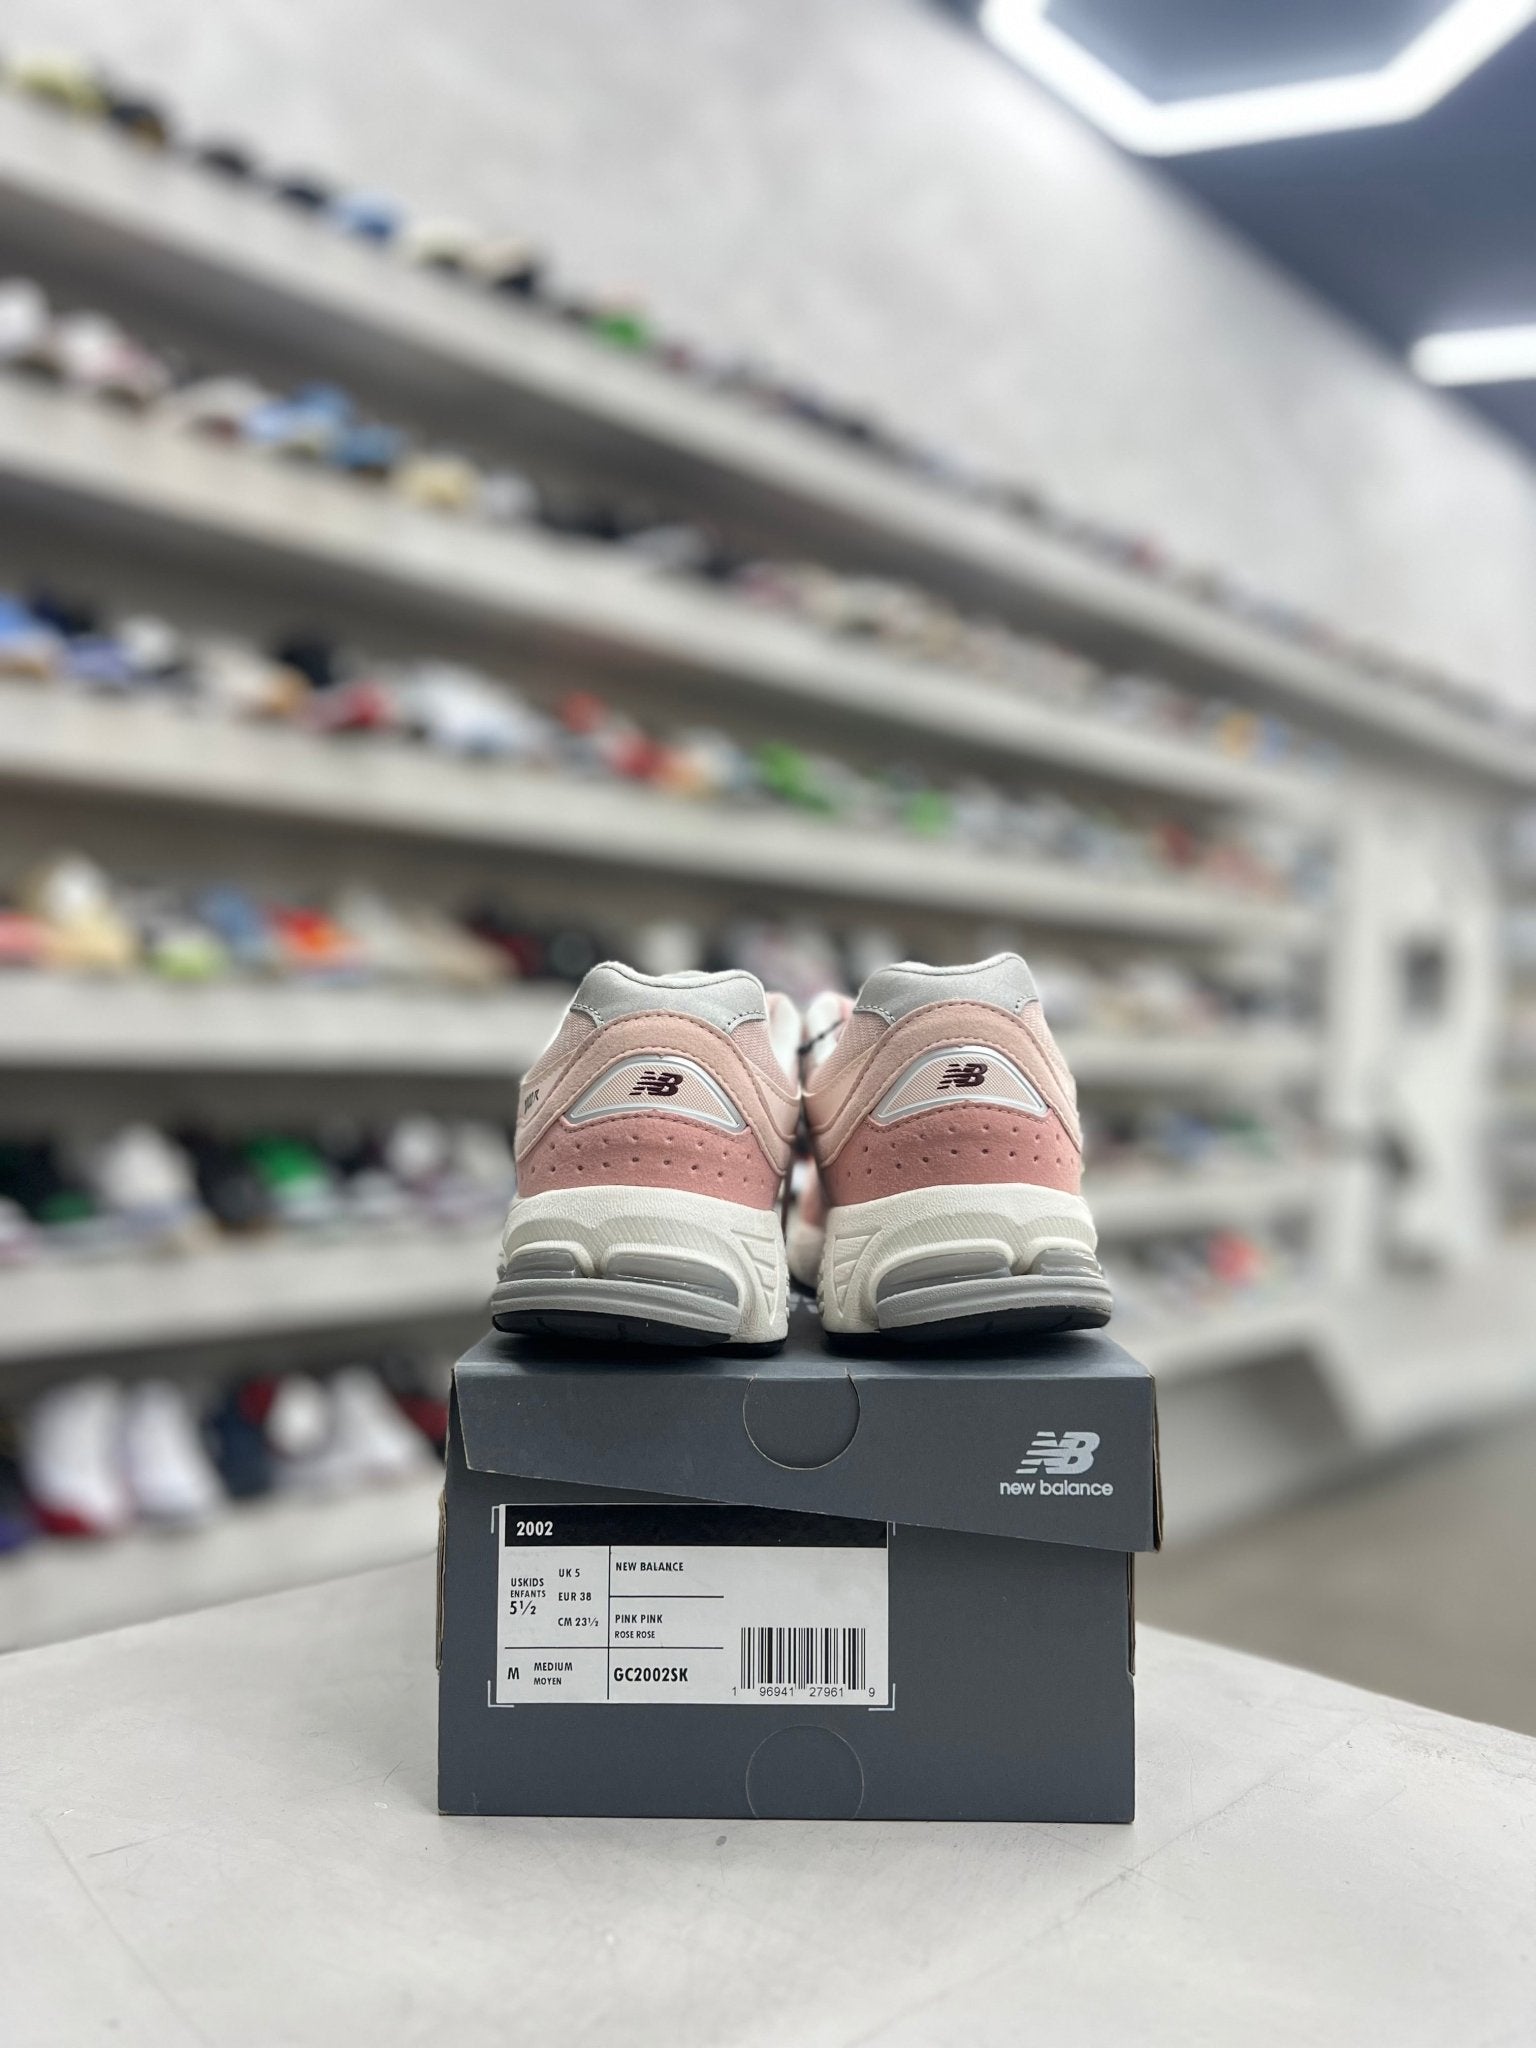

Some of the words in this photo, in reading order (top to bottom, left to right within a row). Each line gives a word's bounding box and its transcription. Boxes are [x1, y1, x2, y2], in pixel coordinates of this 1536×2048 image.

[1015, 1431, 1101, 1475] NB
[1000, 1482, 1036, 1495] new
[1040, 1480, 1114, 1496] balance
[516, 1521, 554, 1537] 2002
[615, 1562, 637, 1571] NEW
[640, 1562, 684, 1572] BALANCE
[558, 1568, 572, 1578] UK
[575, 1568, 581, 1578] 5
[510, 1578, 544, 1587] USKIDS
[510, 1590, 546, 1598] ENFANTS
[558, 1592, 577, 1601] EUR
[580, 1592, 592, 1601] 38
[557, 1617, 572, 1627] CM
[615, 1614, 637, 1623] PINK
[640, 1614, 663, 1624] PINK
[614, 1630, 634, 1639] ROSE
[636, 1631, 655, 1639] ROSE
[533, 1662, 573, 1671] MEDIUM
[507, 1667, 520, 1680] M
[613, 1667, 689, 1682] GC2002SK
[533, 1677, 562, 1685] MOYEN
[731, 1687, 738, 1696] 1
[759, 1686, 795, 1697] 96941
[809, 1687, 844, 1697] 27961
[868, 1687, 876, 1697] 9
